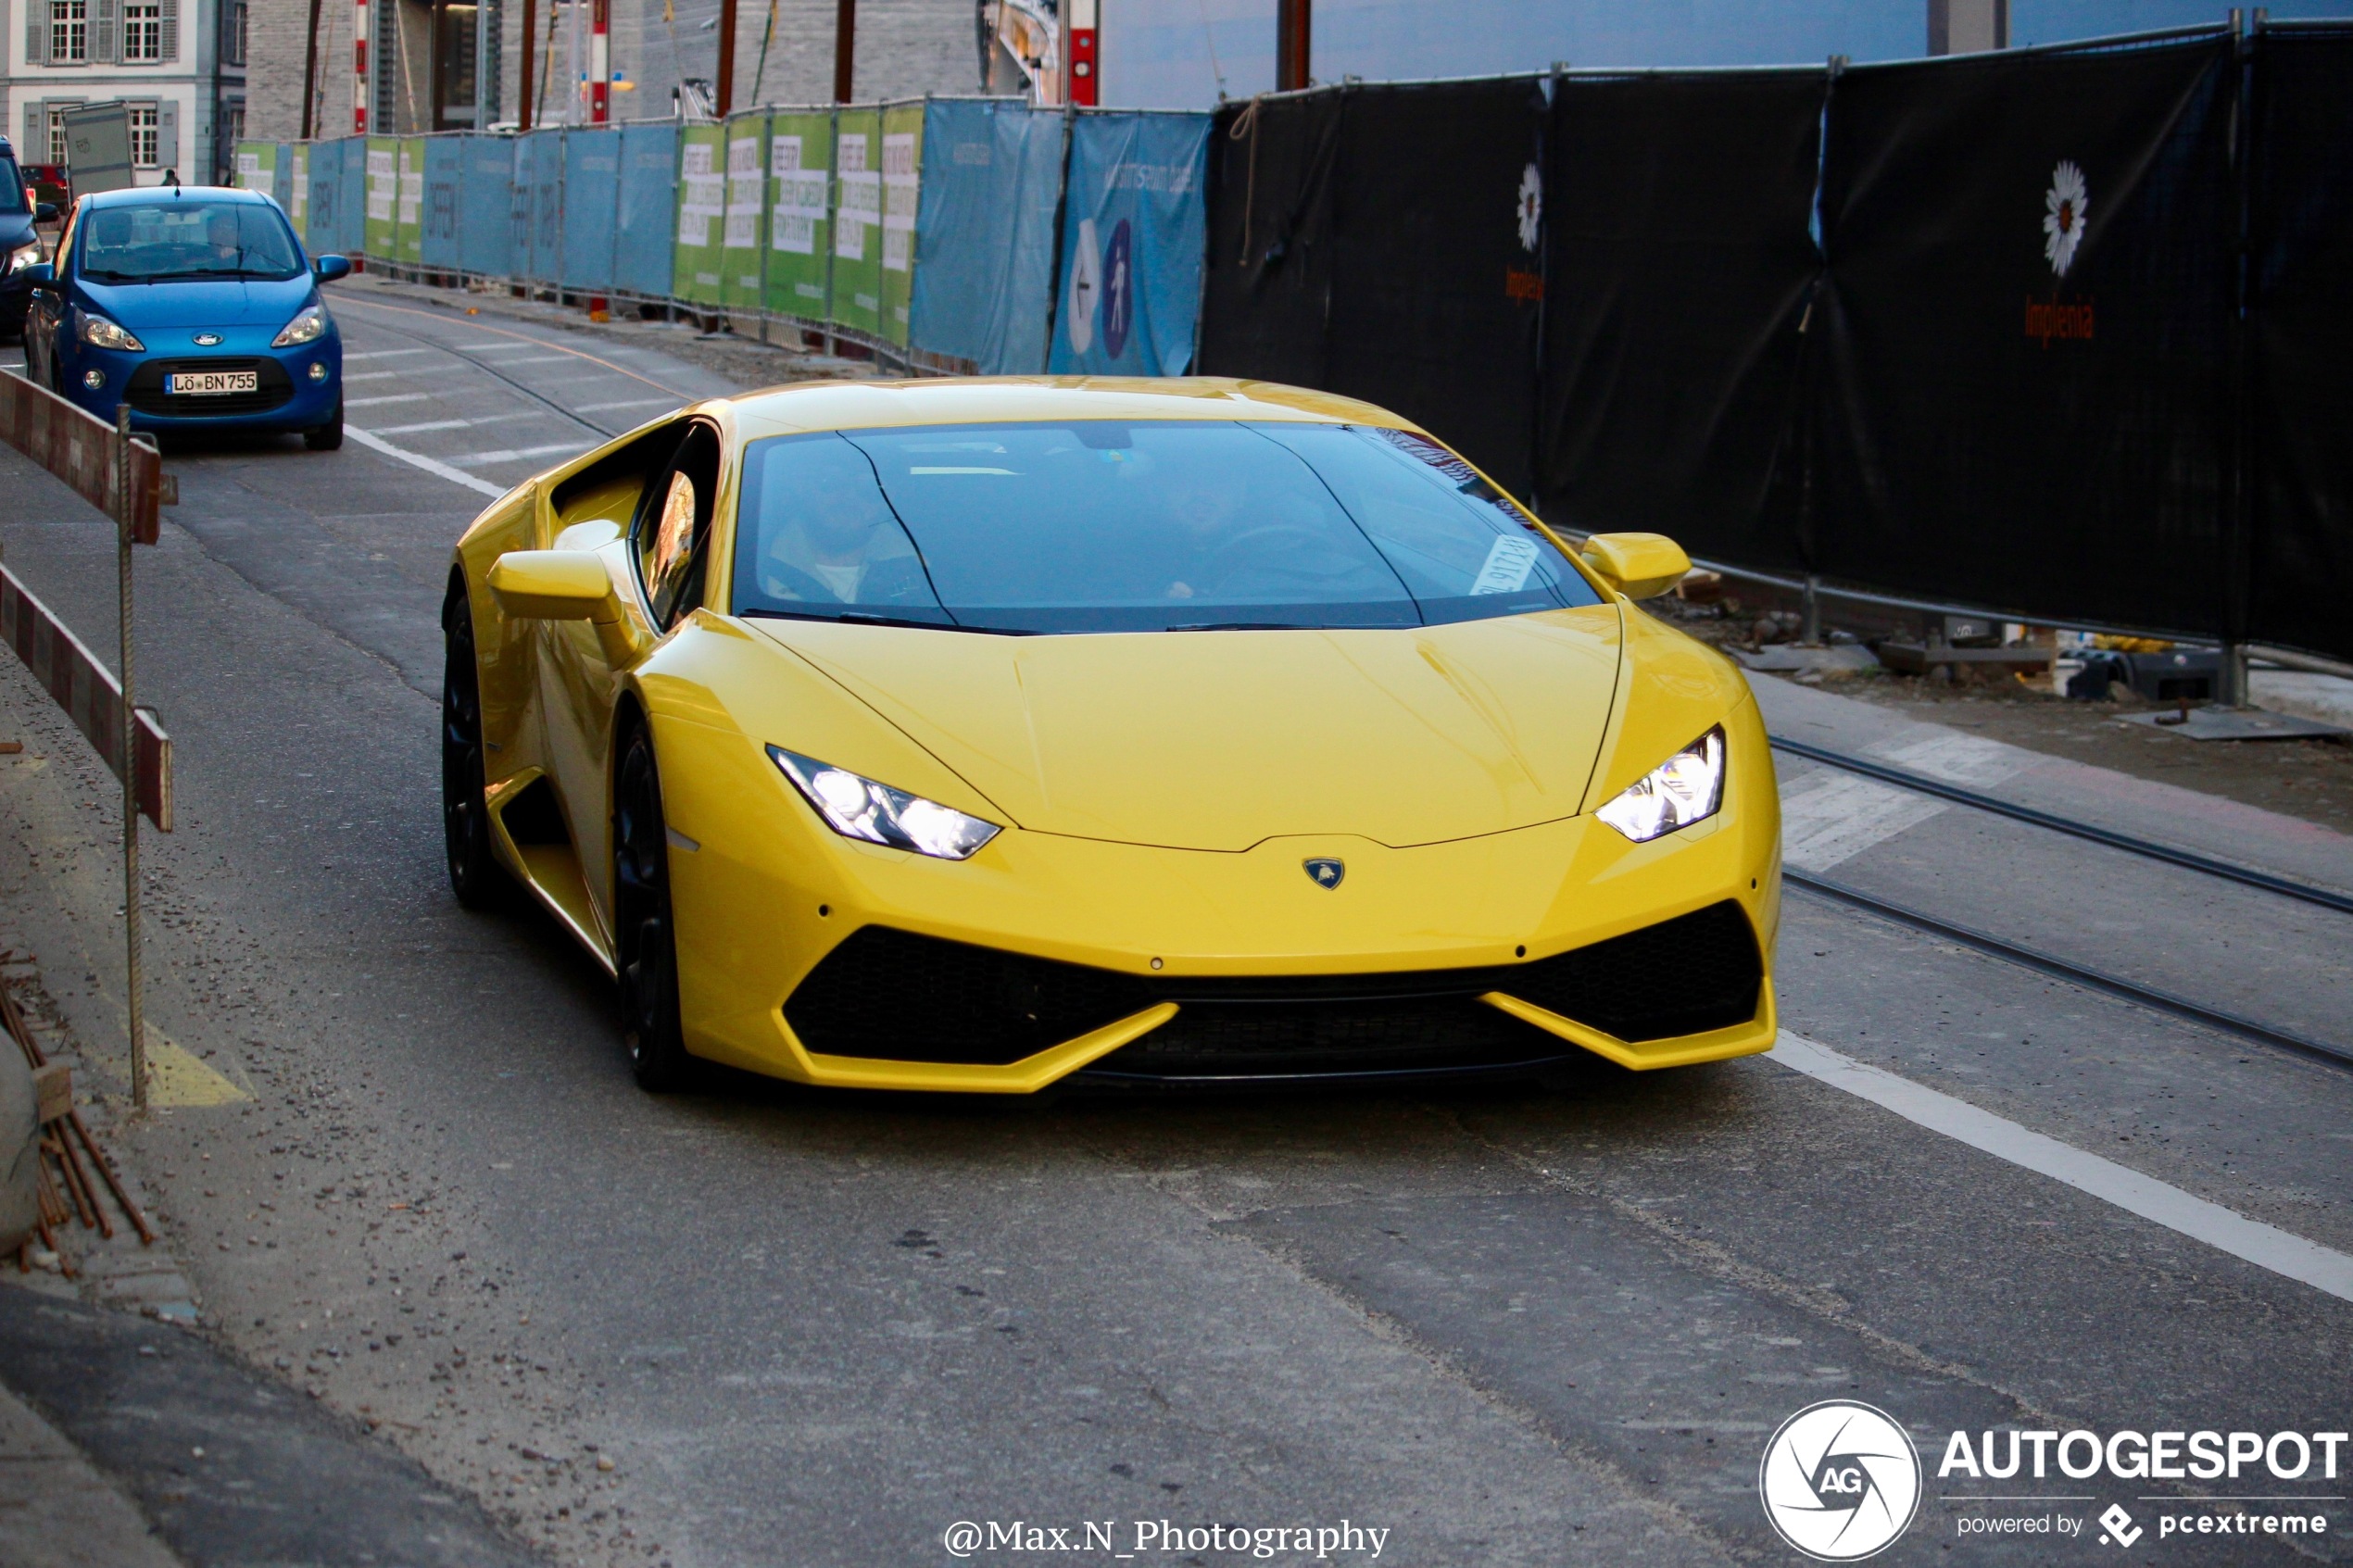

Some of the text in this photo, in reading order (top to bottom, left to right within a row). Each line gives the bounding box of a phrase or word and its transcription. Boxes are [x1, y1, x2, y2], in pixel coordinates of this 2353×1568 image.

[2025, 291, 2095, 350] Implenia
[174, 374, 256, 391] LÖ BN 755
